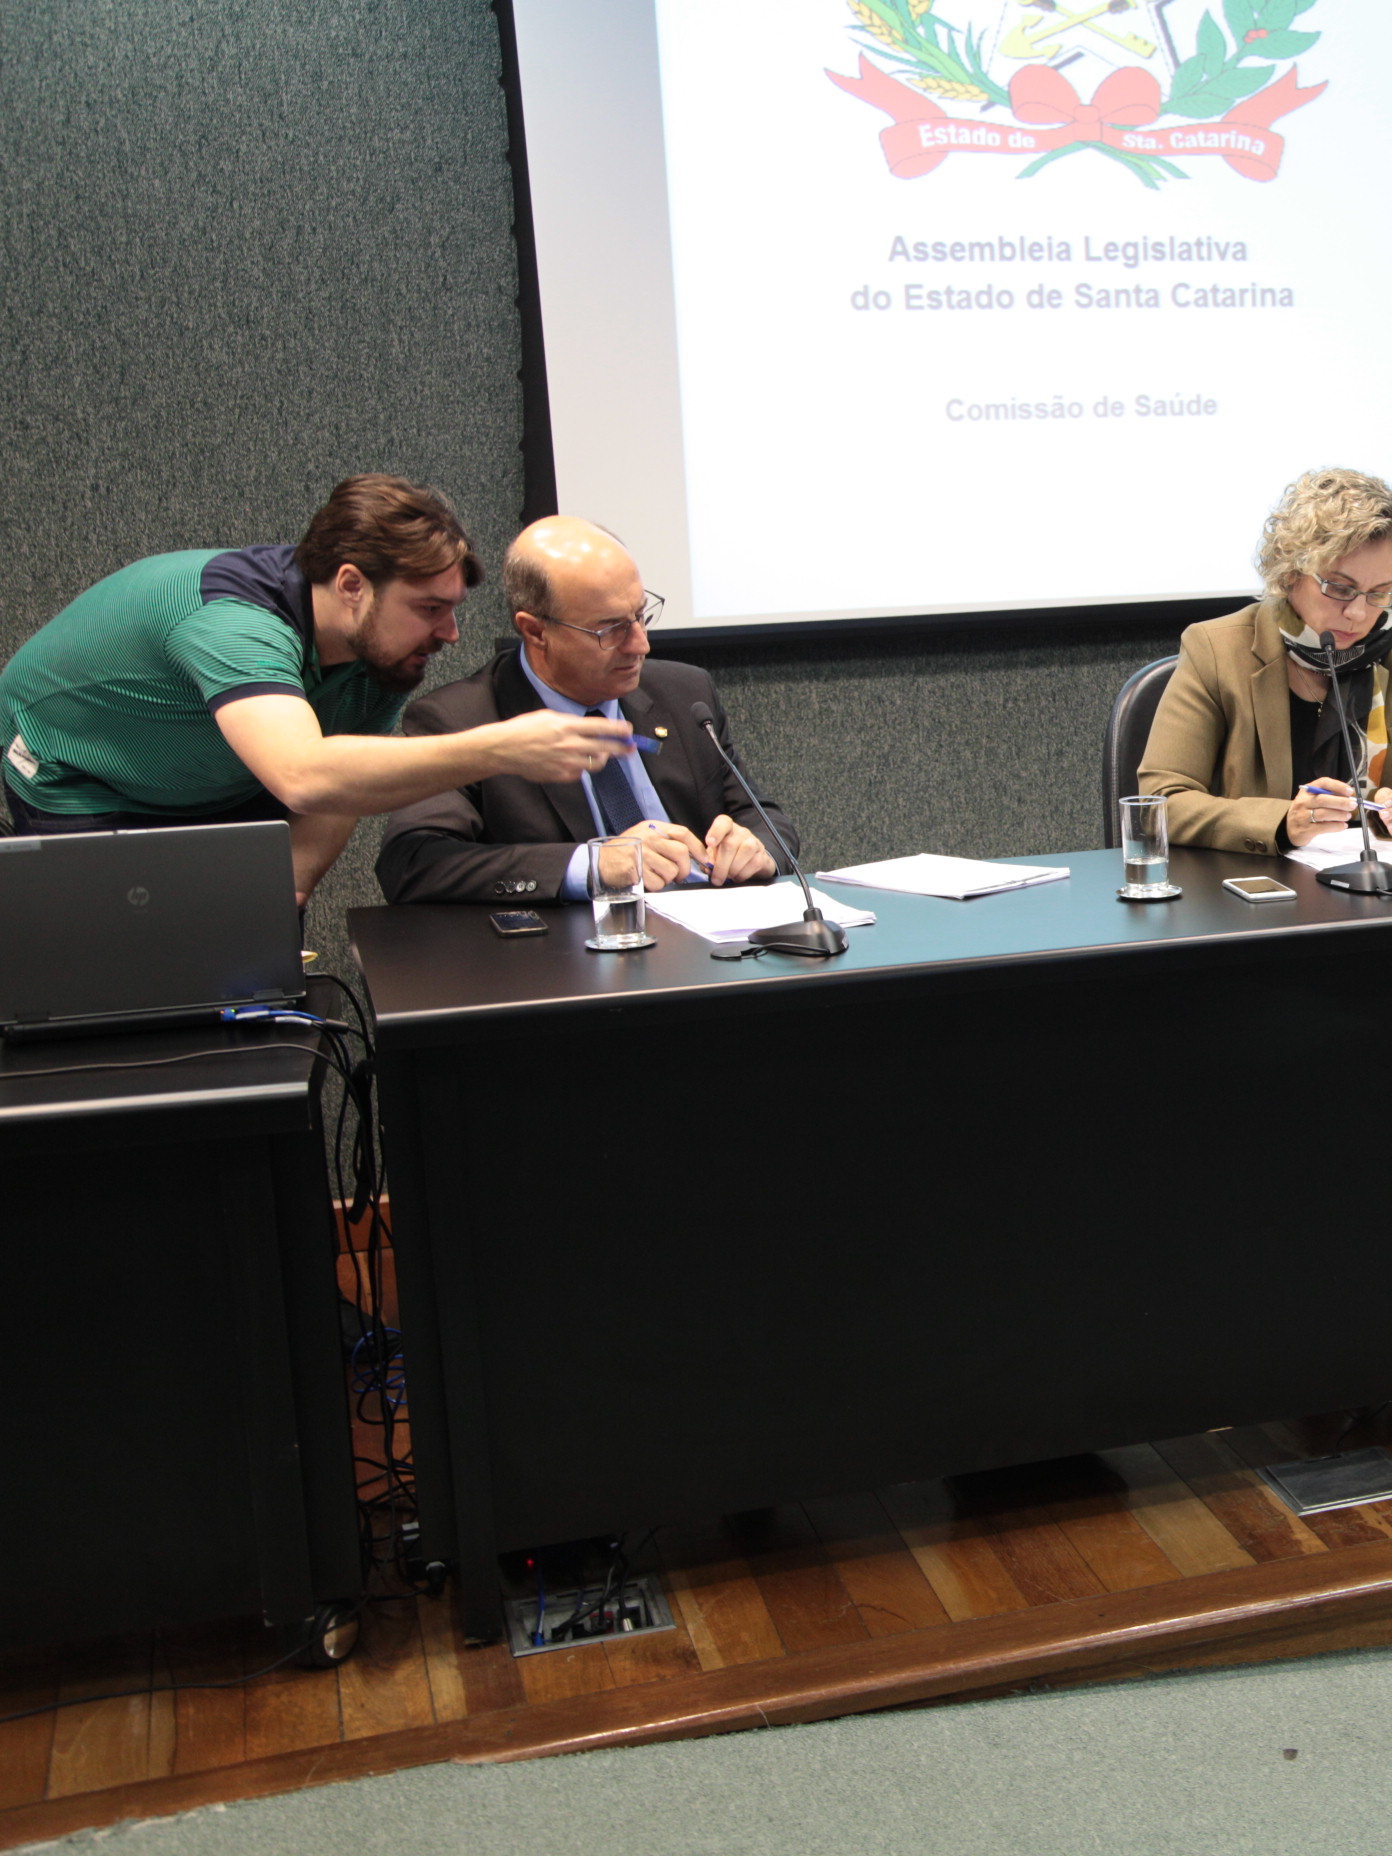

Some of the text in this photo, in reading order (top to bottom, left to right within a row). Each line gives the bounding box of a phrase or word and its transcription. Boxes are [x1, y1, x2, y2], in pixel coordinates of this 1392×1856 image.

[918, 124, 1266, 156] Estado de Sta. Catarina
[888, 235, 1249, 269] Assembleia Legislativa
[850, 281, 1295, 311] do Estado de Santa Catarina
[945, 392, 1218, 422] Comissão de Saúde
